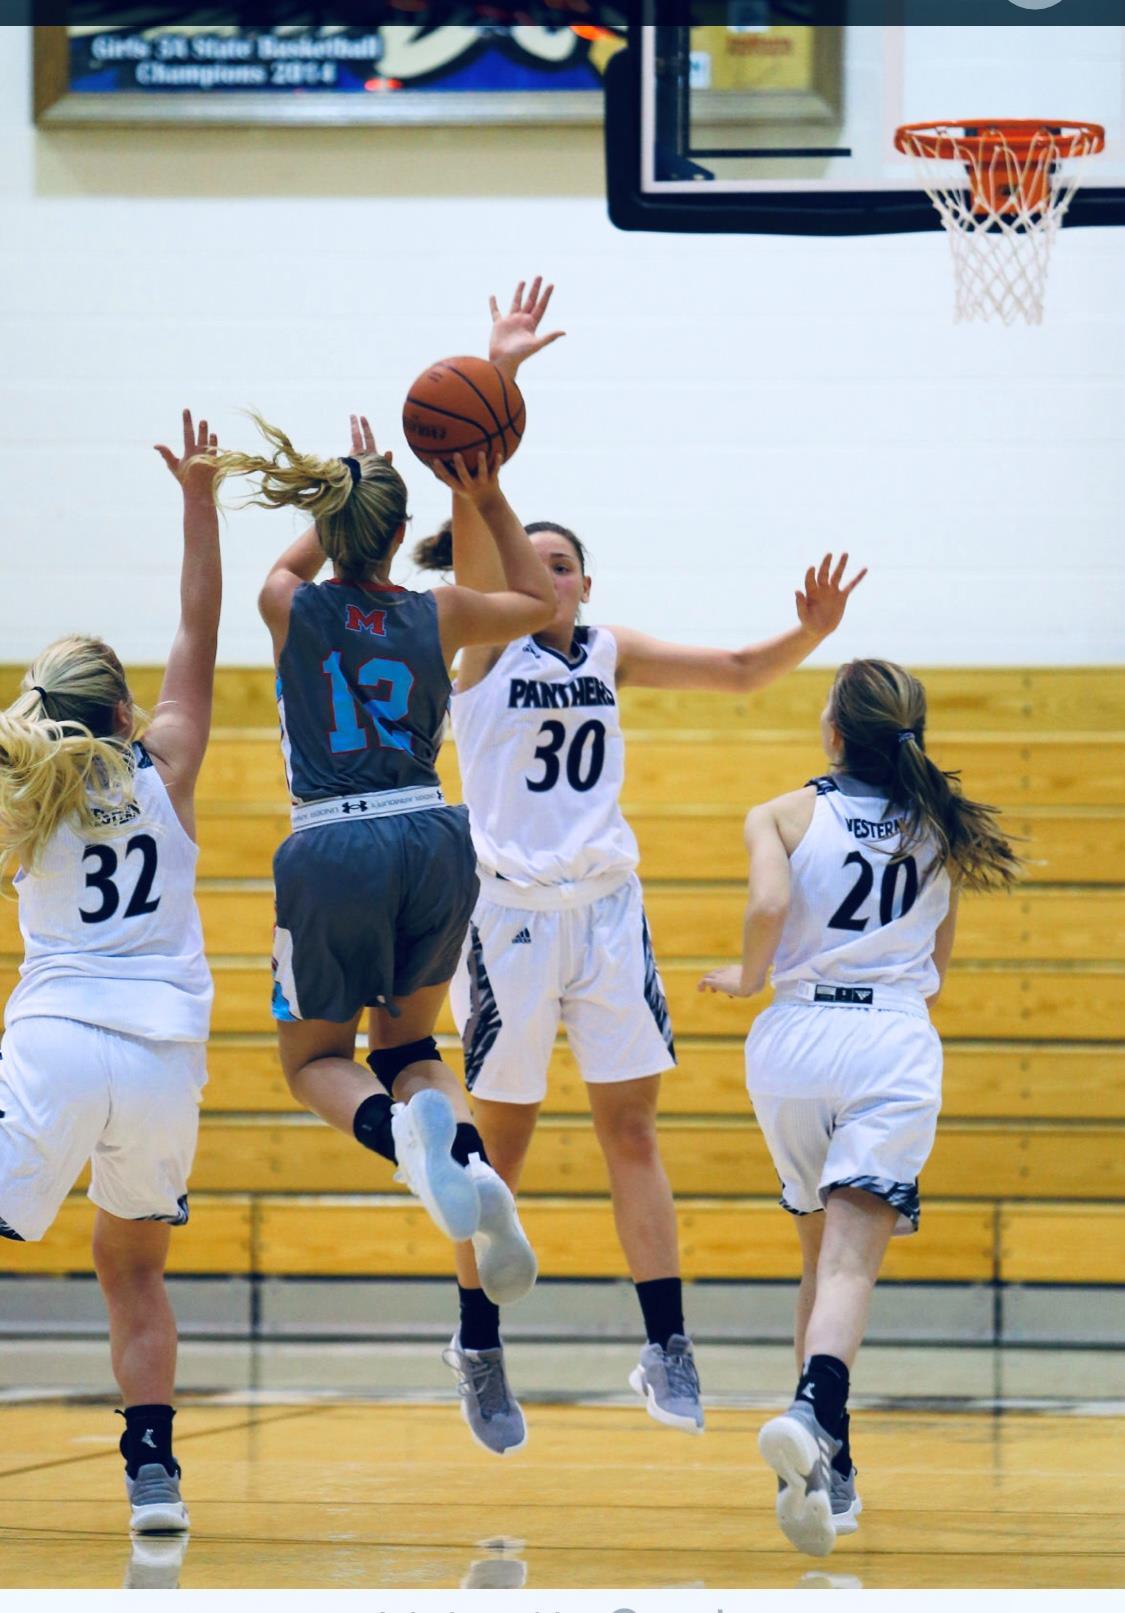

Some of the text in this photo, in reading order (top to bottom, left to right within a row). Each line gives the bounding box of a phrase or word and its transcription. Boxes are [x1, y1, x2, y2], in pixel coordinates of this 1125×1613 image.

[92, 35, 151, 59] Girls
[192, 35, 252, 60] State
[257, 35, 380, 60] Basketball
[135, 61, 266, 89] Champions
[345, 604, 387, 637] M
[320, 650, 415, 754] 12
[508, 676, 616, 709] PANTHERS
[525, 719, 606, 793] 30
[79, 833, 161, 924] 32
[827, 850, 919, 932] 20
